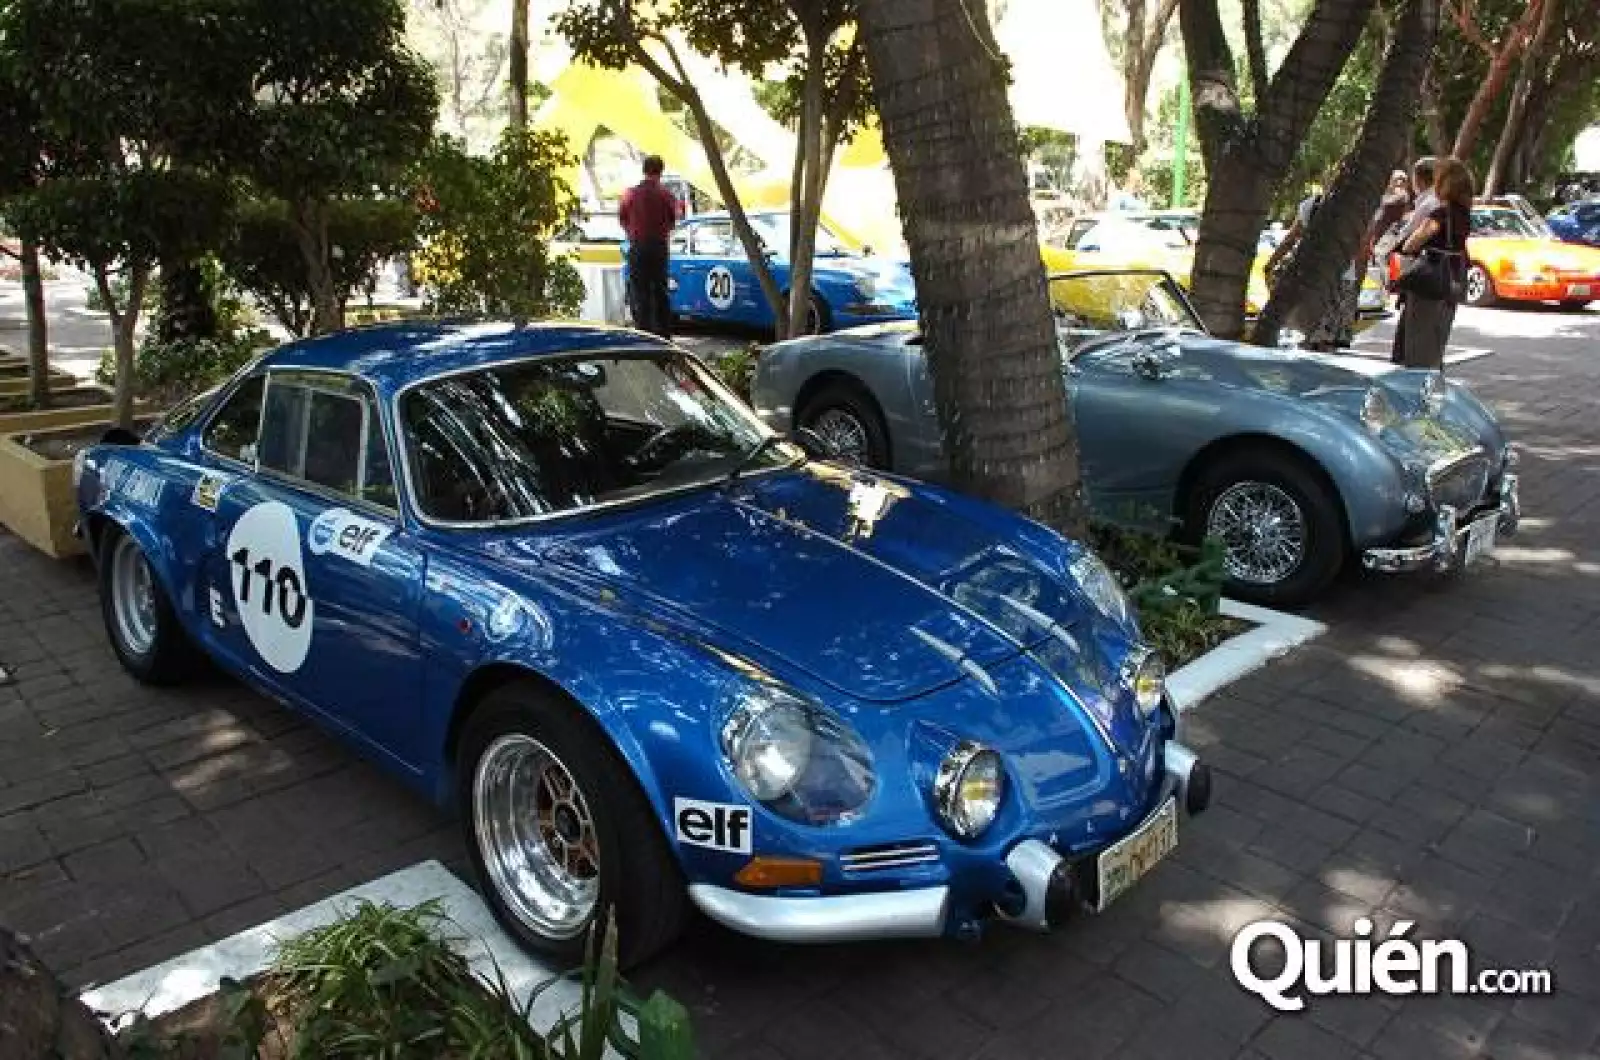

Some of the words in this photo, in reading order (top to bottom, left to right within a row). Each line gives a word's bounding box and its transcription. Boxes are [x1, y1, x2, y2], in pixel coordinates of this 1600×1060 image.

[709, 272, 731, 300] 20
[340, 524, 381, 556] elf
[231, 547, 307, 628] 110
[679, 807, 749, 849] elf
